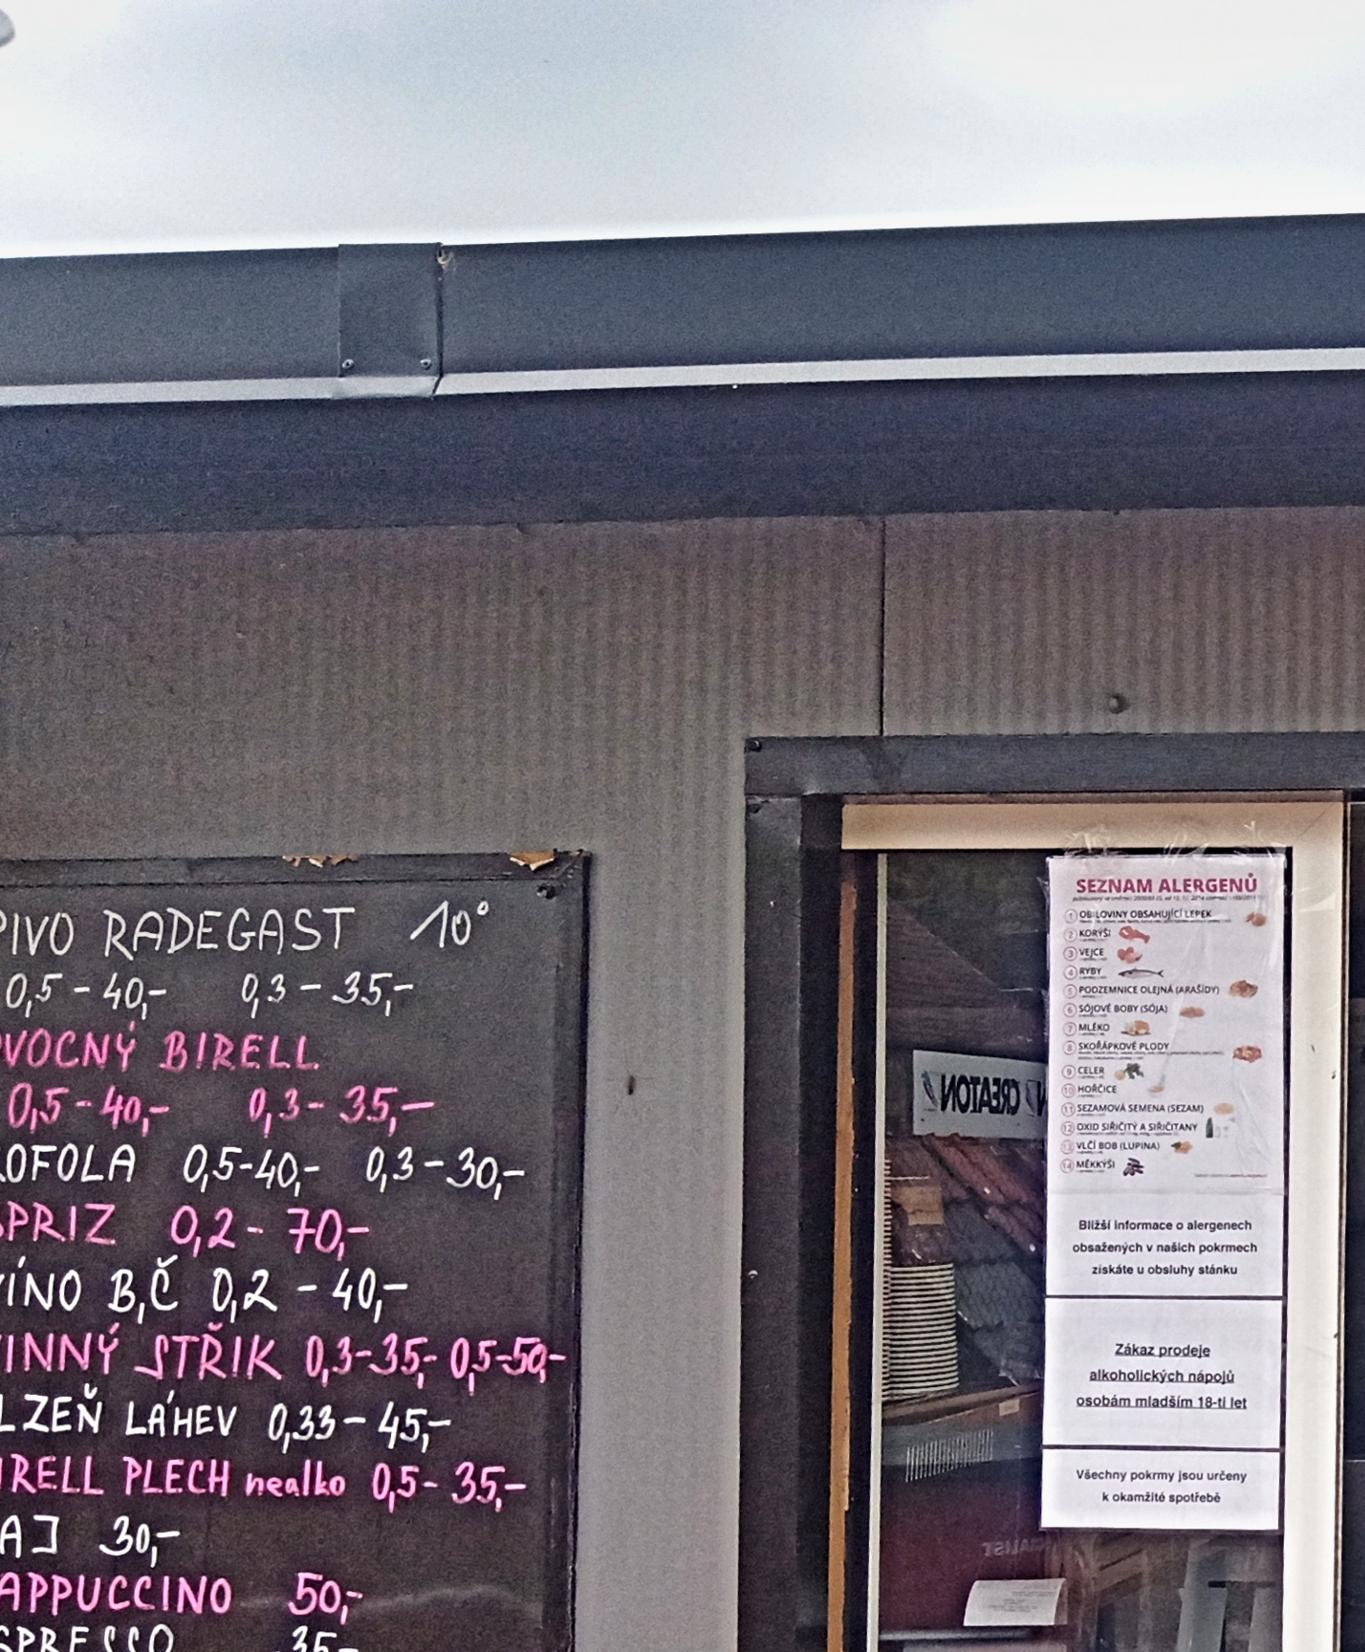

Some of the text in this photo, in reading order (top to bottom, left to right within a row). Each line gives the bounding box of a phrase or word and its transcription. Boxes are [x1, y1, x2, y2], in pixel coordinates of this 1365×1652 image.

[1076, 872, 1257, 893] SEZNAM ALERGENŮ
[103, 908, 356, 960] RADEGAST
[1079, 948, 1104, 957] VEJCE
[1079, 967, 1102, 975] RYBY
[1079, 985, 1137, 994] PODZEMNICE
[1140, 984, 1173, 995] OLEJNÁ
[1114, 1004, 1138, 1013] BOBY
[1079, 1023, 1110, 1032] MLÉKO
[160, 1034, 321, 1072] BIRELL
[1139, 1042, 1170, 1051] PLODY
[1078, 1066, 1105, 1075] CELER
[1077, 1084, 1117, 1094] HOŘČICE
[1077, 1103, 1127, 1112] SEZAMOVÁ
[1128, 1104, 1166, 1113] SEMENA
[1076, 1123, 1100, 1131] OXID
[1099, 1142, 1118, 1150] BOB
[0, 1144, 137, 1183] OFOLA
[0, 1204, 116, 1246] PRIZ
[1176, 1222, 1184, 1230] o
[1187, 1220, 1252, 1233] alergenech
[1073, 1242, 1257, 1255] obsažených v našich pokrmech
[1092, 1265, 1238, 1277] získáte u obsluhy stánku
[1115, 1343, 1211, 1358] Zákaz prodeje
[1089, 1369, 1235, 1384] alkoholických nápojů
[1076, 1396, 1131, 1408] osobám
[1135, 1396, 1193, 1408] mladším
[1230, 1397, 1247, 1409] let
[125, 1390, 237, 1438] LÁHEV
[123, 1458, 346, 1498] PLECH nealko
[1076, 1469, 1247, 1483] Všechny pokrmy jsou určeny
[1103, 1491, 1221, 1504] k okamžité spotřebě
